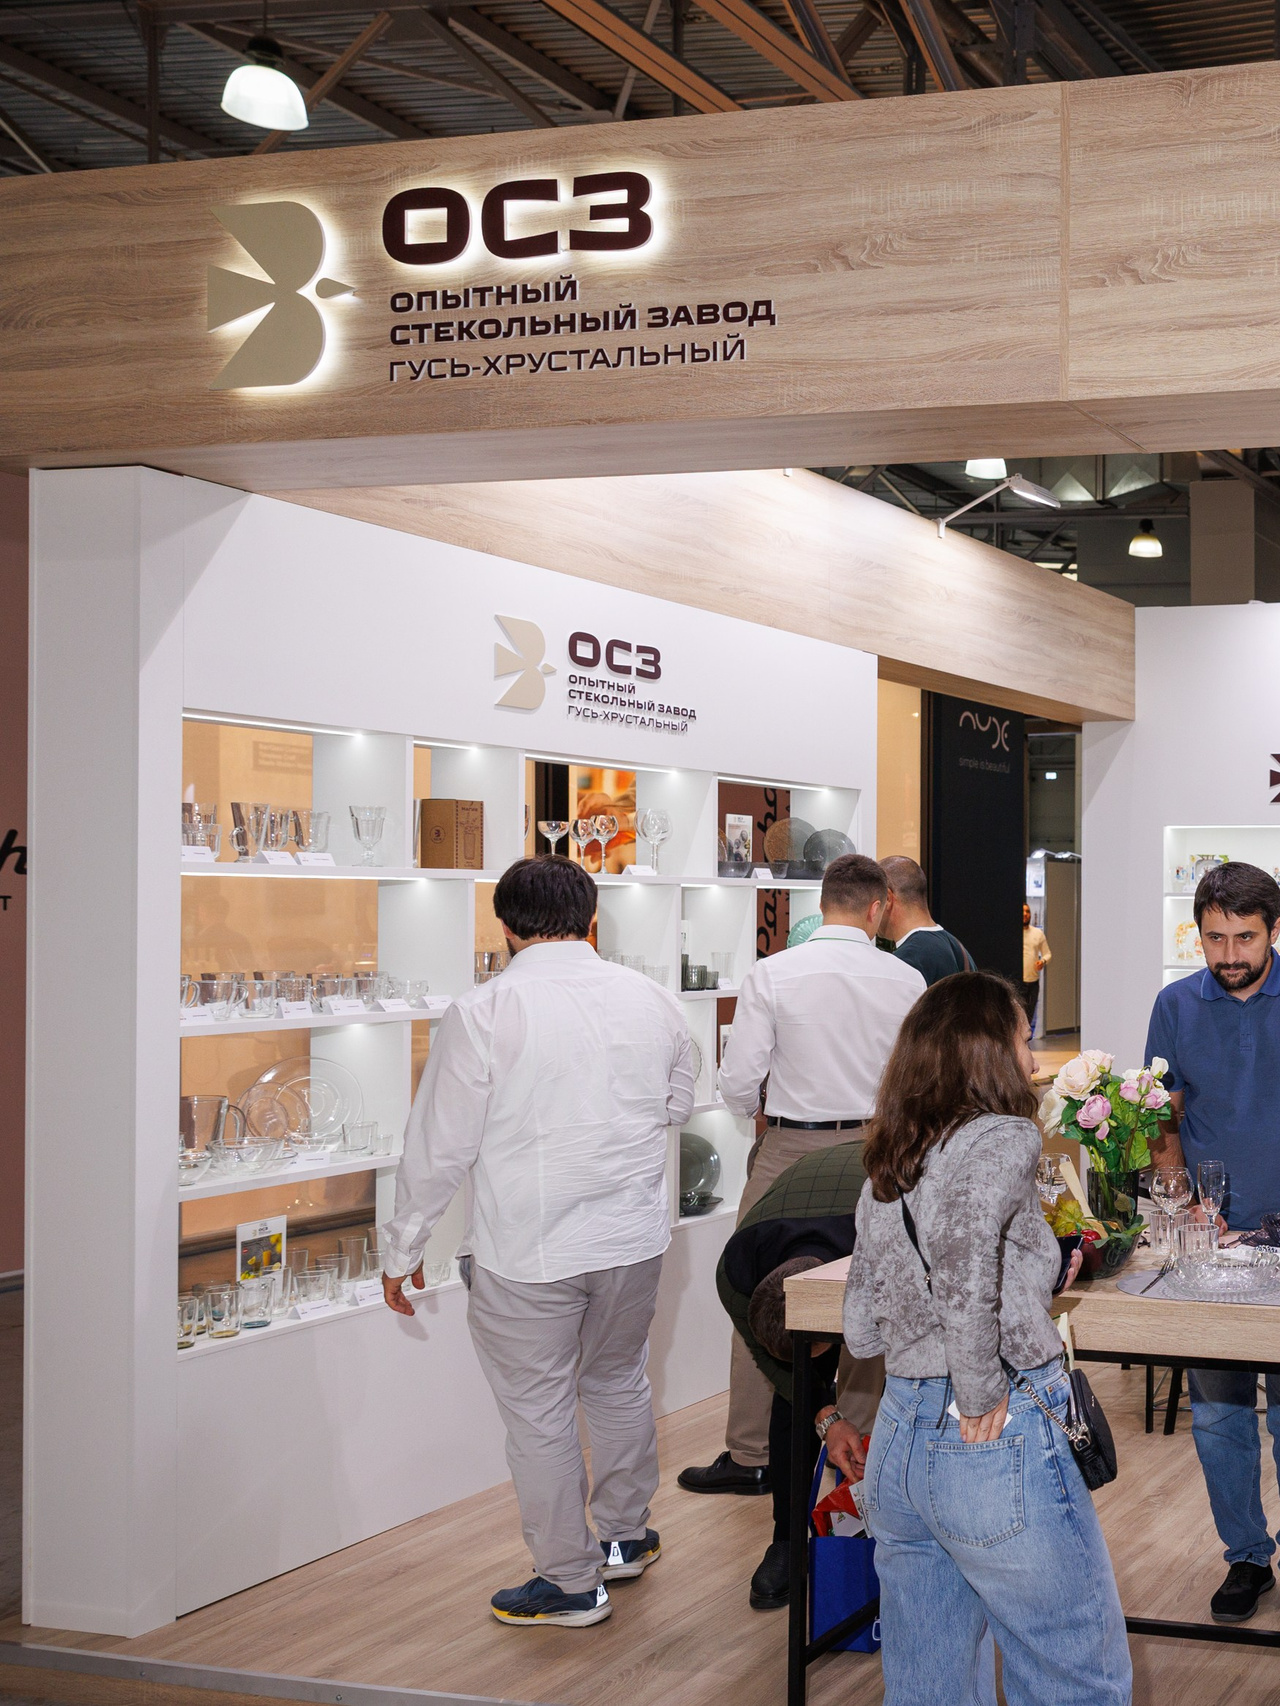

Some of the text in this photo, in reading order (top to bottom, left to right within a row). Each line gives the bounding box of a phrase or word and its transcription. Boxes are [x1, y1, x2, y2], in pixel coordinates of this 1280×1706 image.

[382, 171, 654, 265] ОСЗ
[390, 274, 579, 313] ОПЫТНЫЙ
[390, 300, 777, 345] СТЕКОЛЬНЫЙ ЗАВОД
[389, 333, 747, 381] ГУСЬ-ХРУСТАЛЬНЫЙ
[568, 631, 662, 680] ОСЗ
[568, 674, 636, 695] ОПЫТНЫЙ
[568, 689, 697, 721] СТЕКОЛЬНЫЙ ЗАВОД
[567, 705, 689, 733] ГУСЬ-ХРУСТАЛЬНЫЙ
